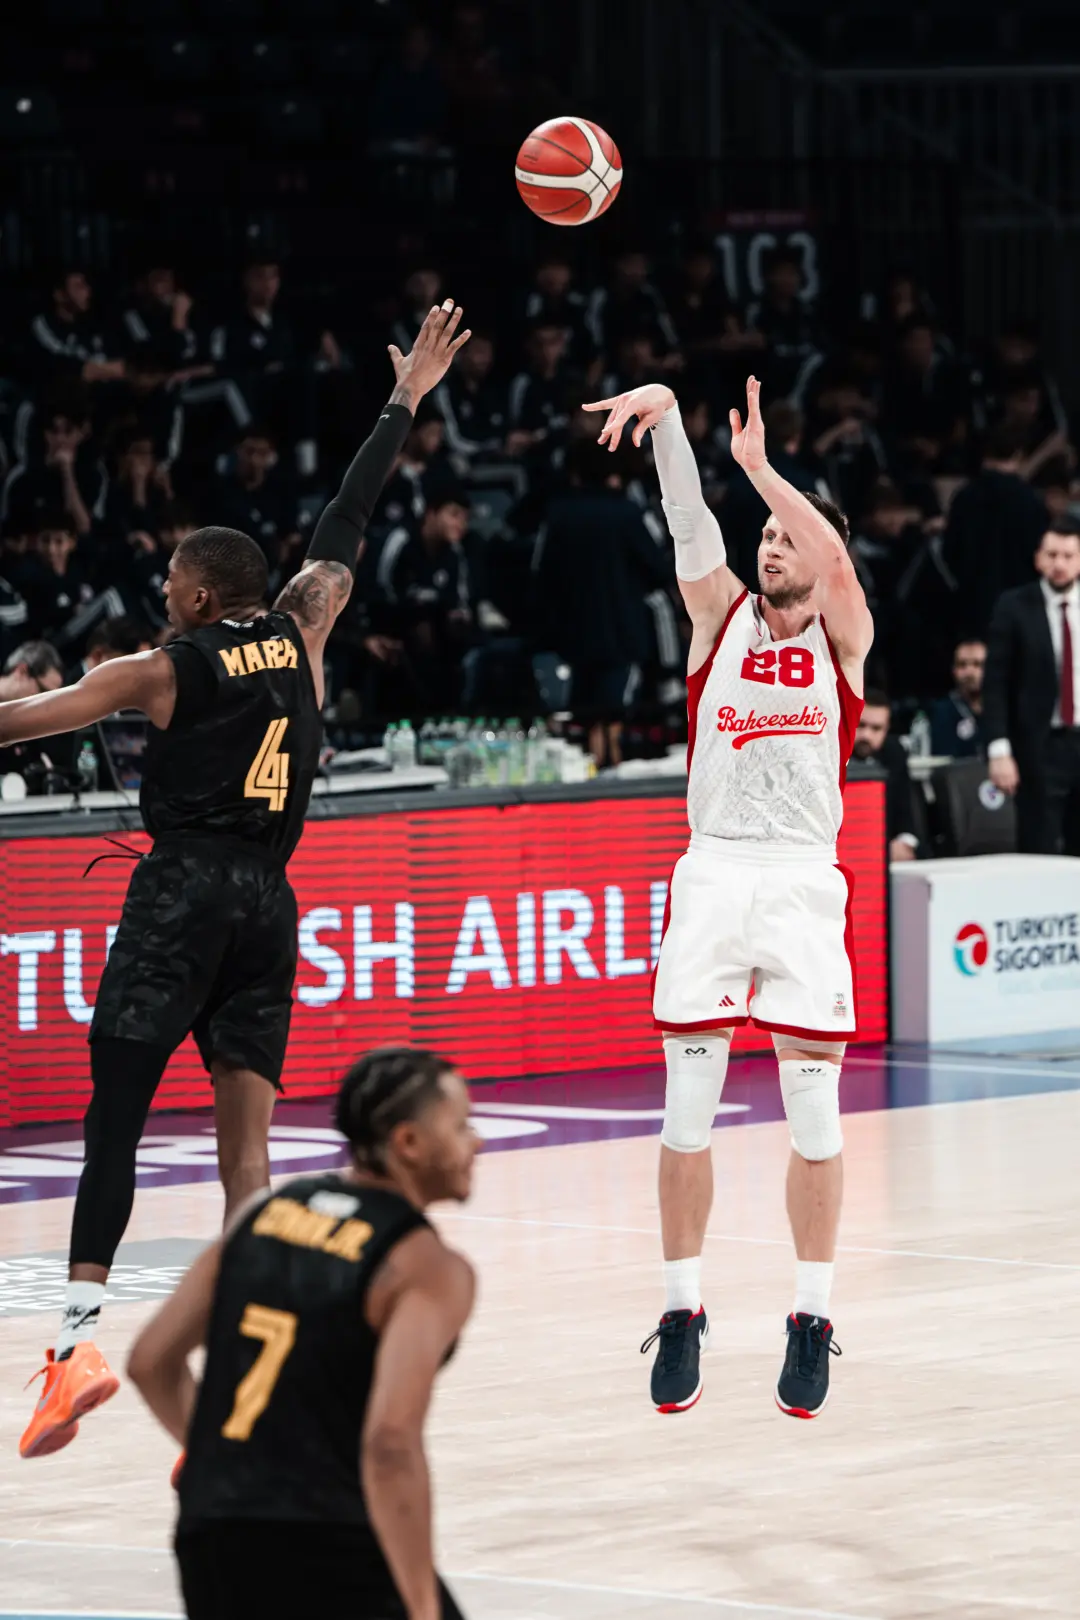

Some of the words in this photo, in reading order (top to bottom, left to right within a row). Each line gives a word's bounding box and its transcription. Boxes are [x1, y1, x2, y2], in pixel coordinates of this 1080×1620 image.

[740, 646, 814, 688] 28
[243, 716, 290, 811] 4
[0, 902, 415, 1031] TUSH
[221, 1302, 298, 1442] 7
